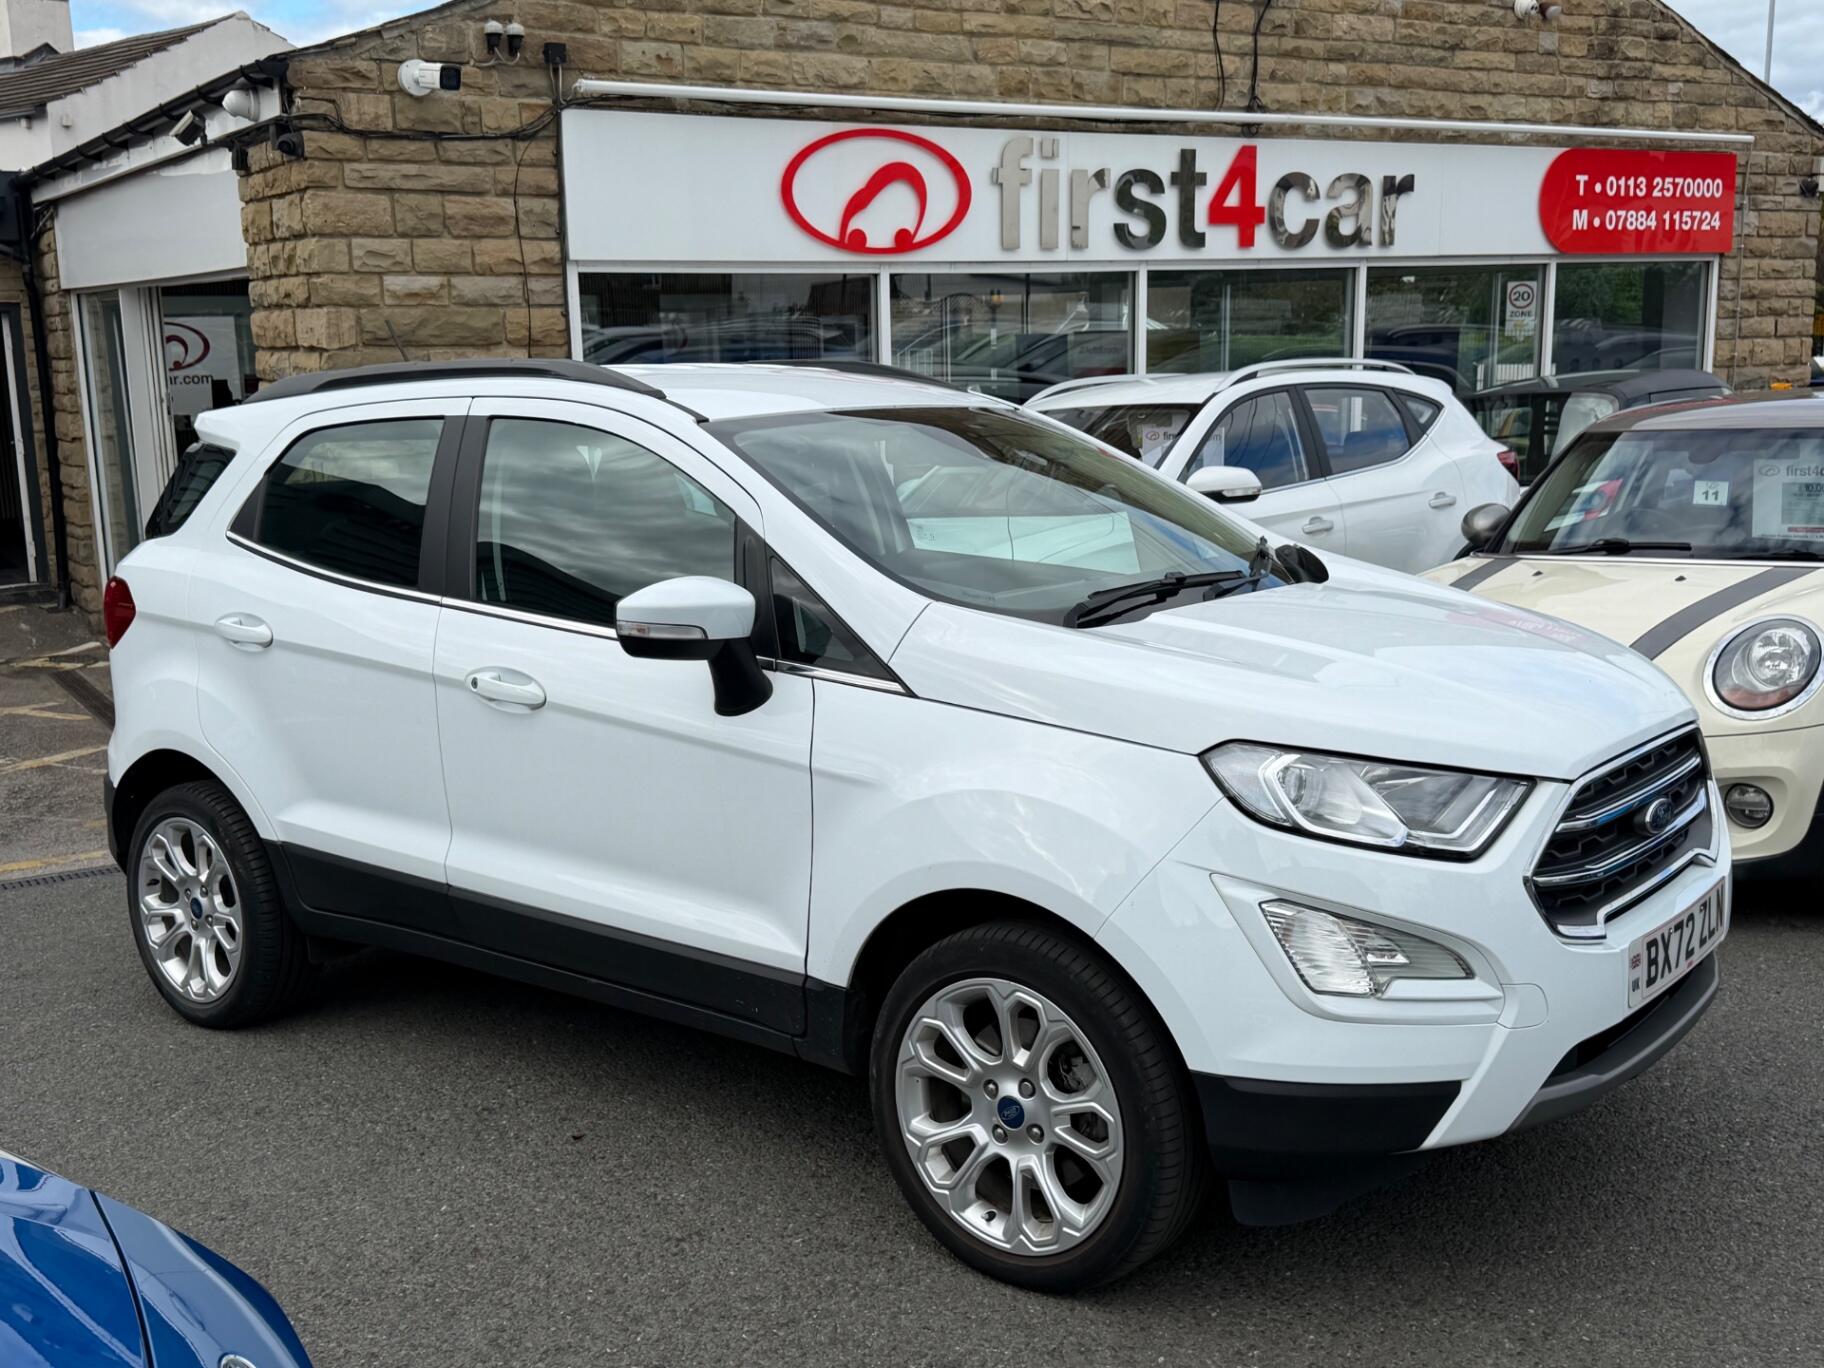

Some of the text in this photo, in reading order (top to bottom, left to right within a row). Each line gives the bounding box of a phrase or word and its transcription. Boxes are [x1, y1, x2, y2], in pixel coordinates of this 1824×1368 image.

[992, 136, 1415, 250] first4car
[1575, 174, 1723, 198] T 0113 2570000
[1572, 209, 1721, 231] M 07884 115724
[1512, 290, 1531, 302] 20
[1509, 310, 1533, 318] ZONE
[1701, 489, 1720, 502] 11
[1645, 883, 1724, 989] BX72 ZLN
